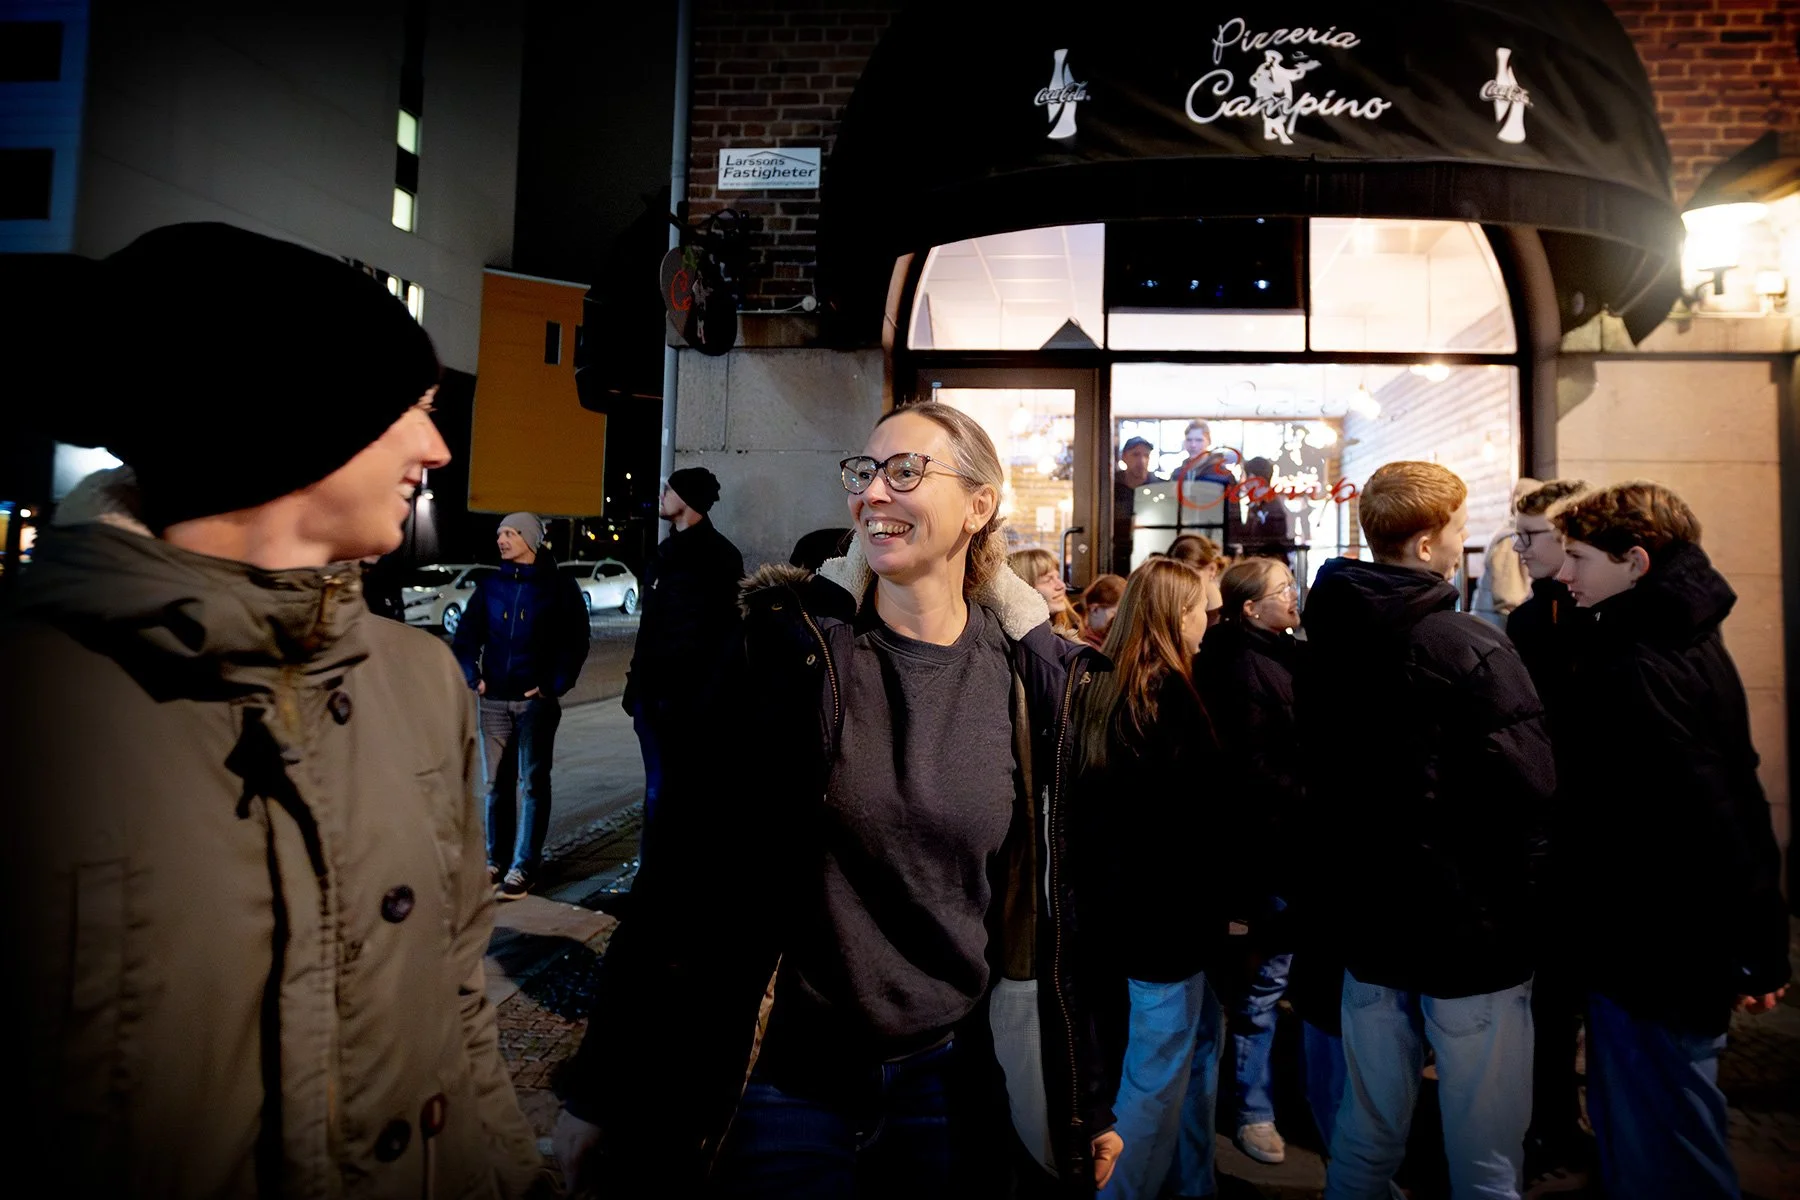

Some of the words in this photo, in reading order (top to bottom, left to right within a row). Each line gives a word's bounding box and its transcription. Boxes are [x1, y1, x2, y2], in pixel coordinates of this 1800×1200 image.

[1212, 17, 1361, 65] Pizzeria
[1185, 68, 1392, 135] Campino
[723, 167, 816, 180] Fastigheter
[725, 155, 785, 166] Larssons
